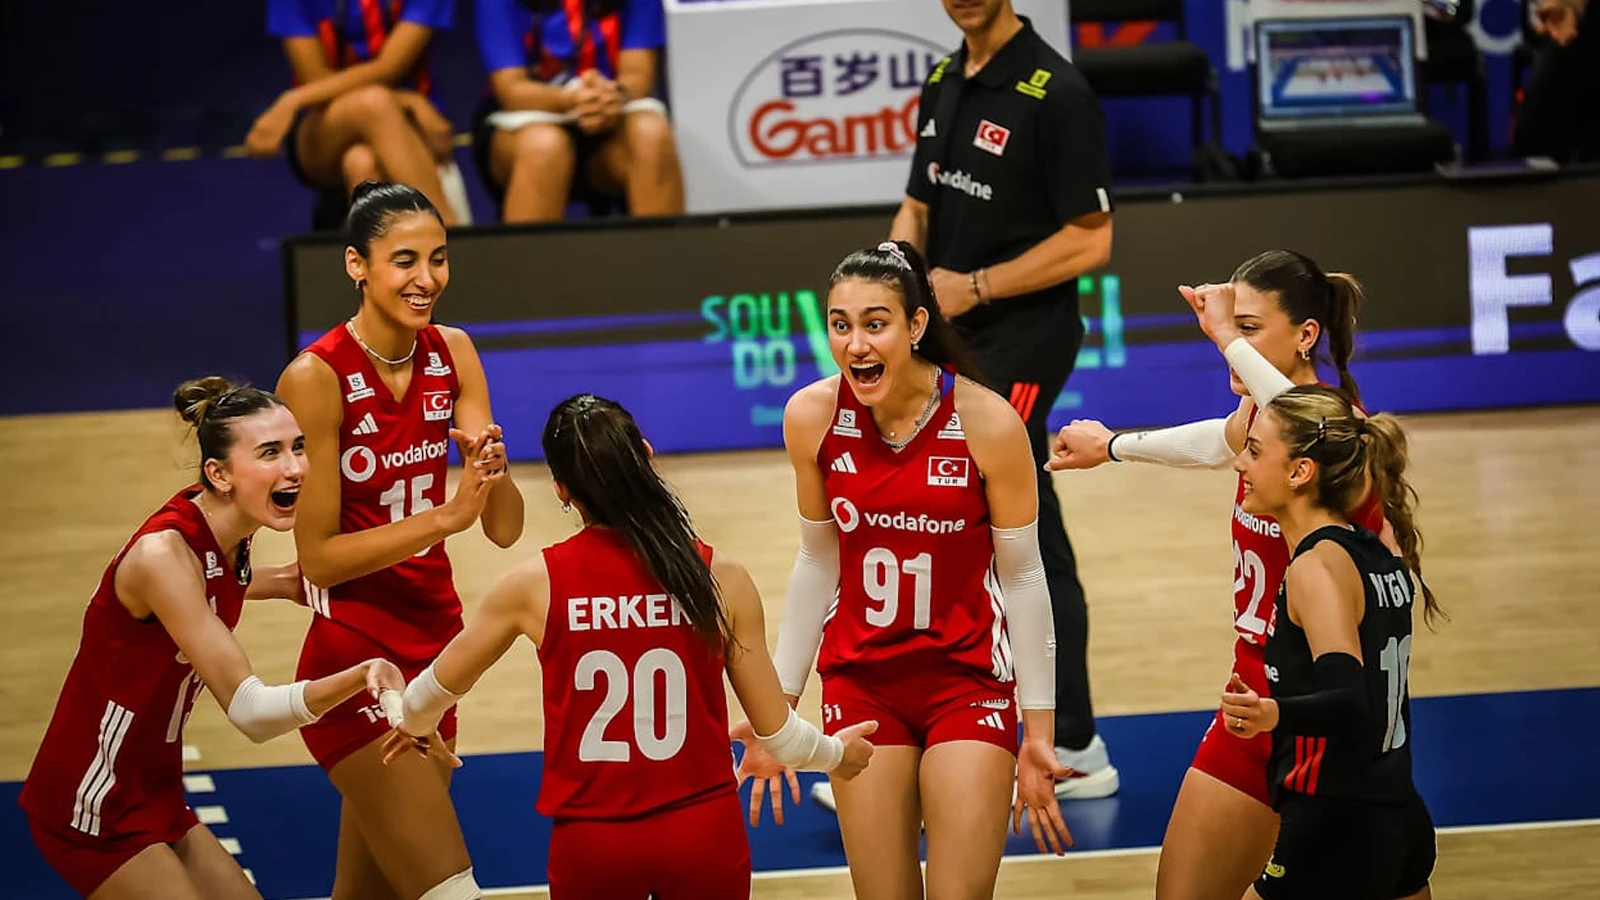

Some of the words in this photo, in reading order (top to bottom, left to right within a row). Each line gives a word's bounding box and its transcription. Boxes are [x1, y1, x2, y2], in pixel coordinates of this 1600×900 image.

[781, 52, 934, 98] 百岁山
[700, 292, 790, 342] SOU
[732, 340, 796, 389] DO
[843, 413, 852, 424] S
[379, 473, 434, 557] 15
[864, 511, 965, 534] vodafone
[863, 547, 932, 630] 91
[575, 648, 687, 762] 20
